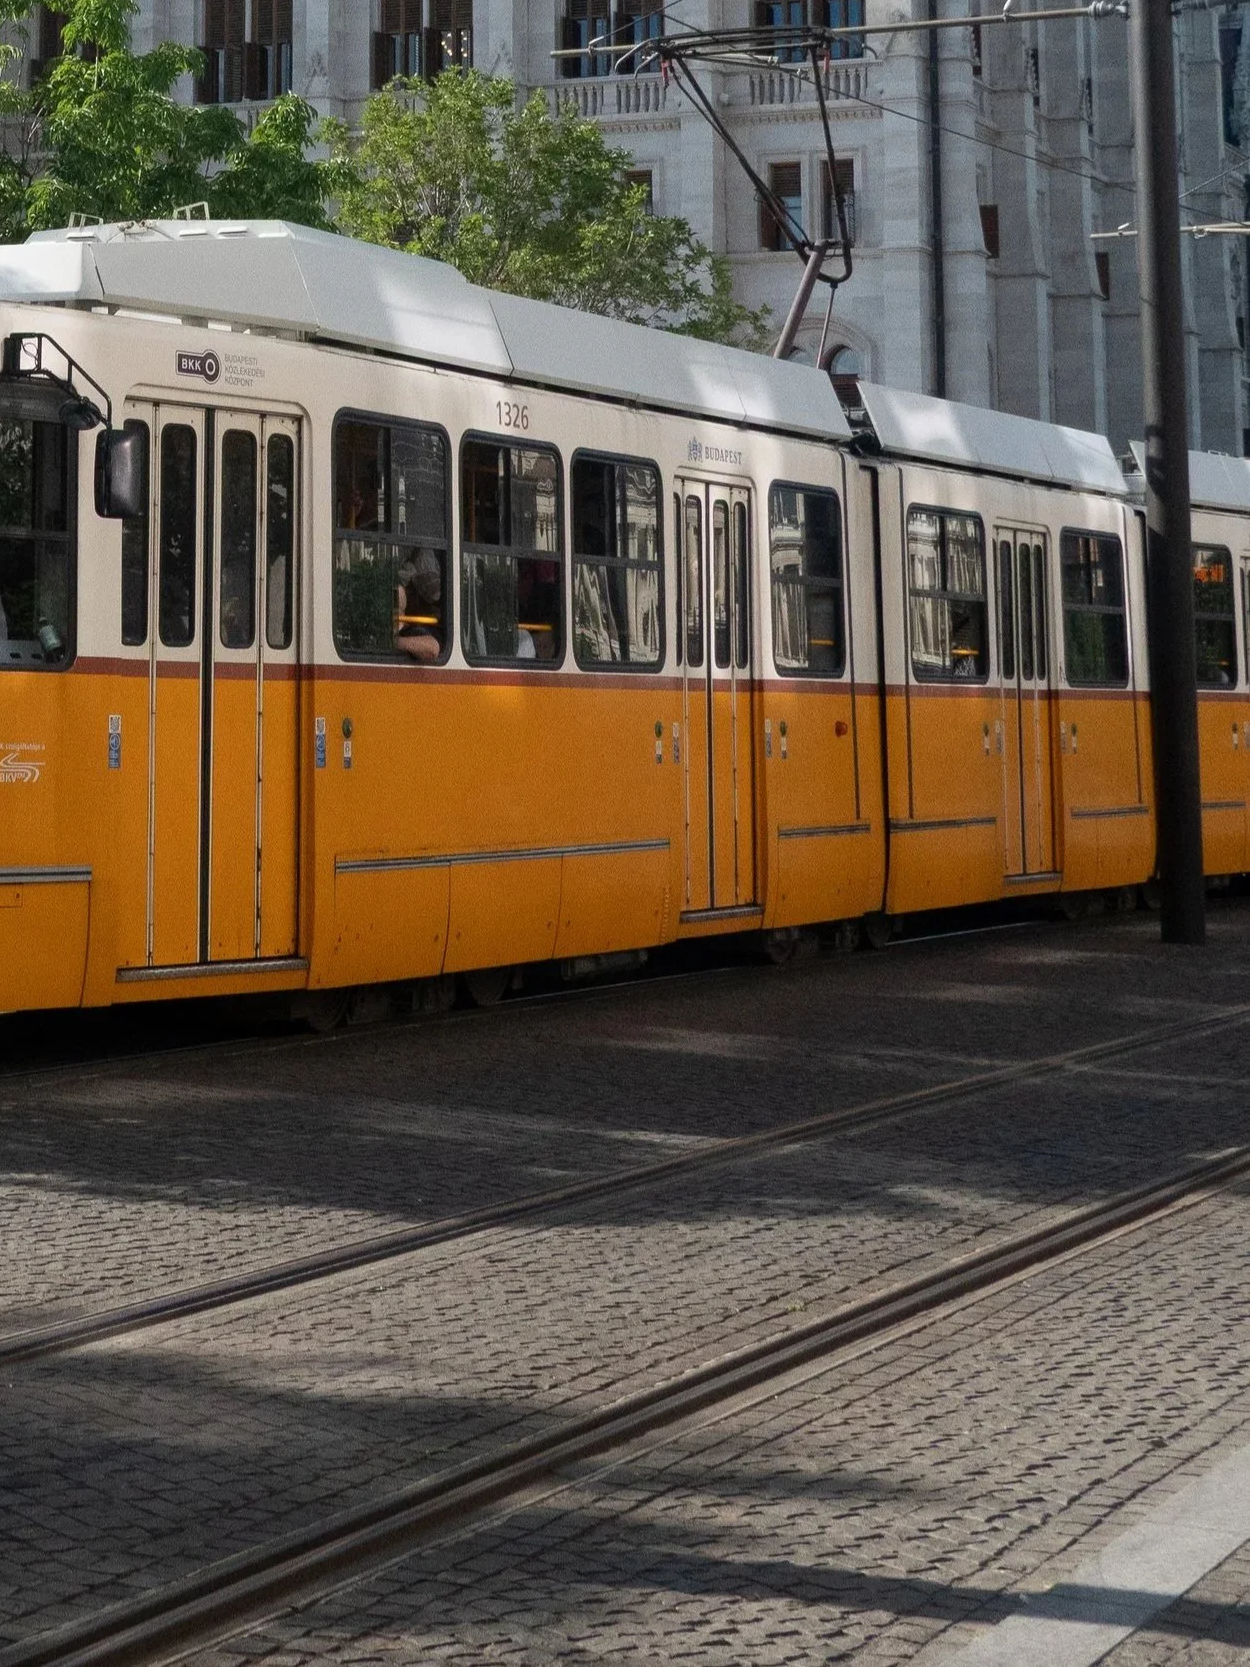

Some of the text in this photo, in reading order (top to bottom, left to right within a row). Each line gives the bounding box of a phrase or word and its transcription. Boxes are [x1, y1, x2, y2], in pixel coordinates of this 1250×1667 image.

[181, 358, 201, 371] BKK
[224, 354, 258, 366] BUDAPESTI
[496, 400, 529, 430] 1326
[704, 446, 742, 465] BUDAPEST
